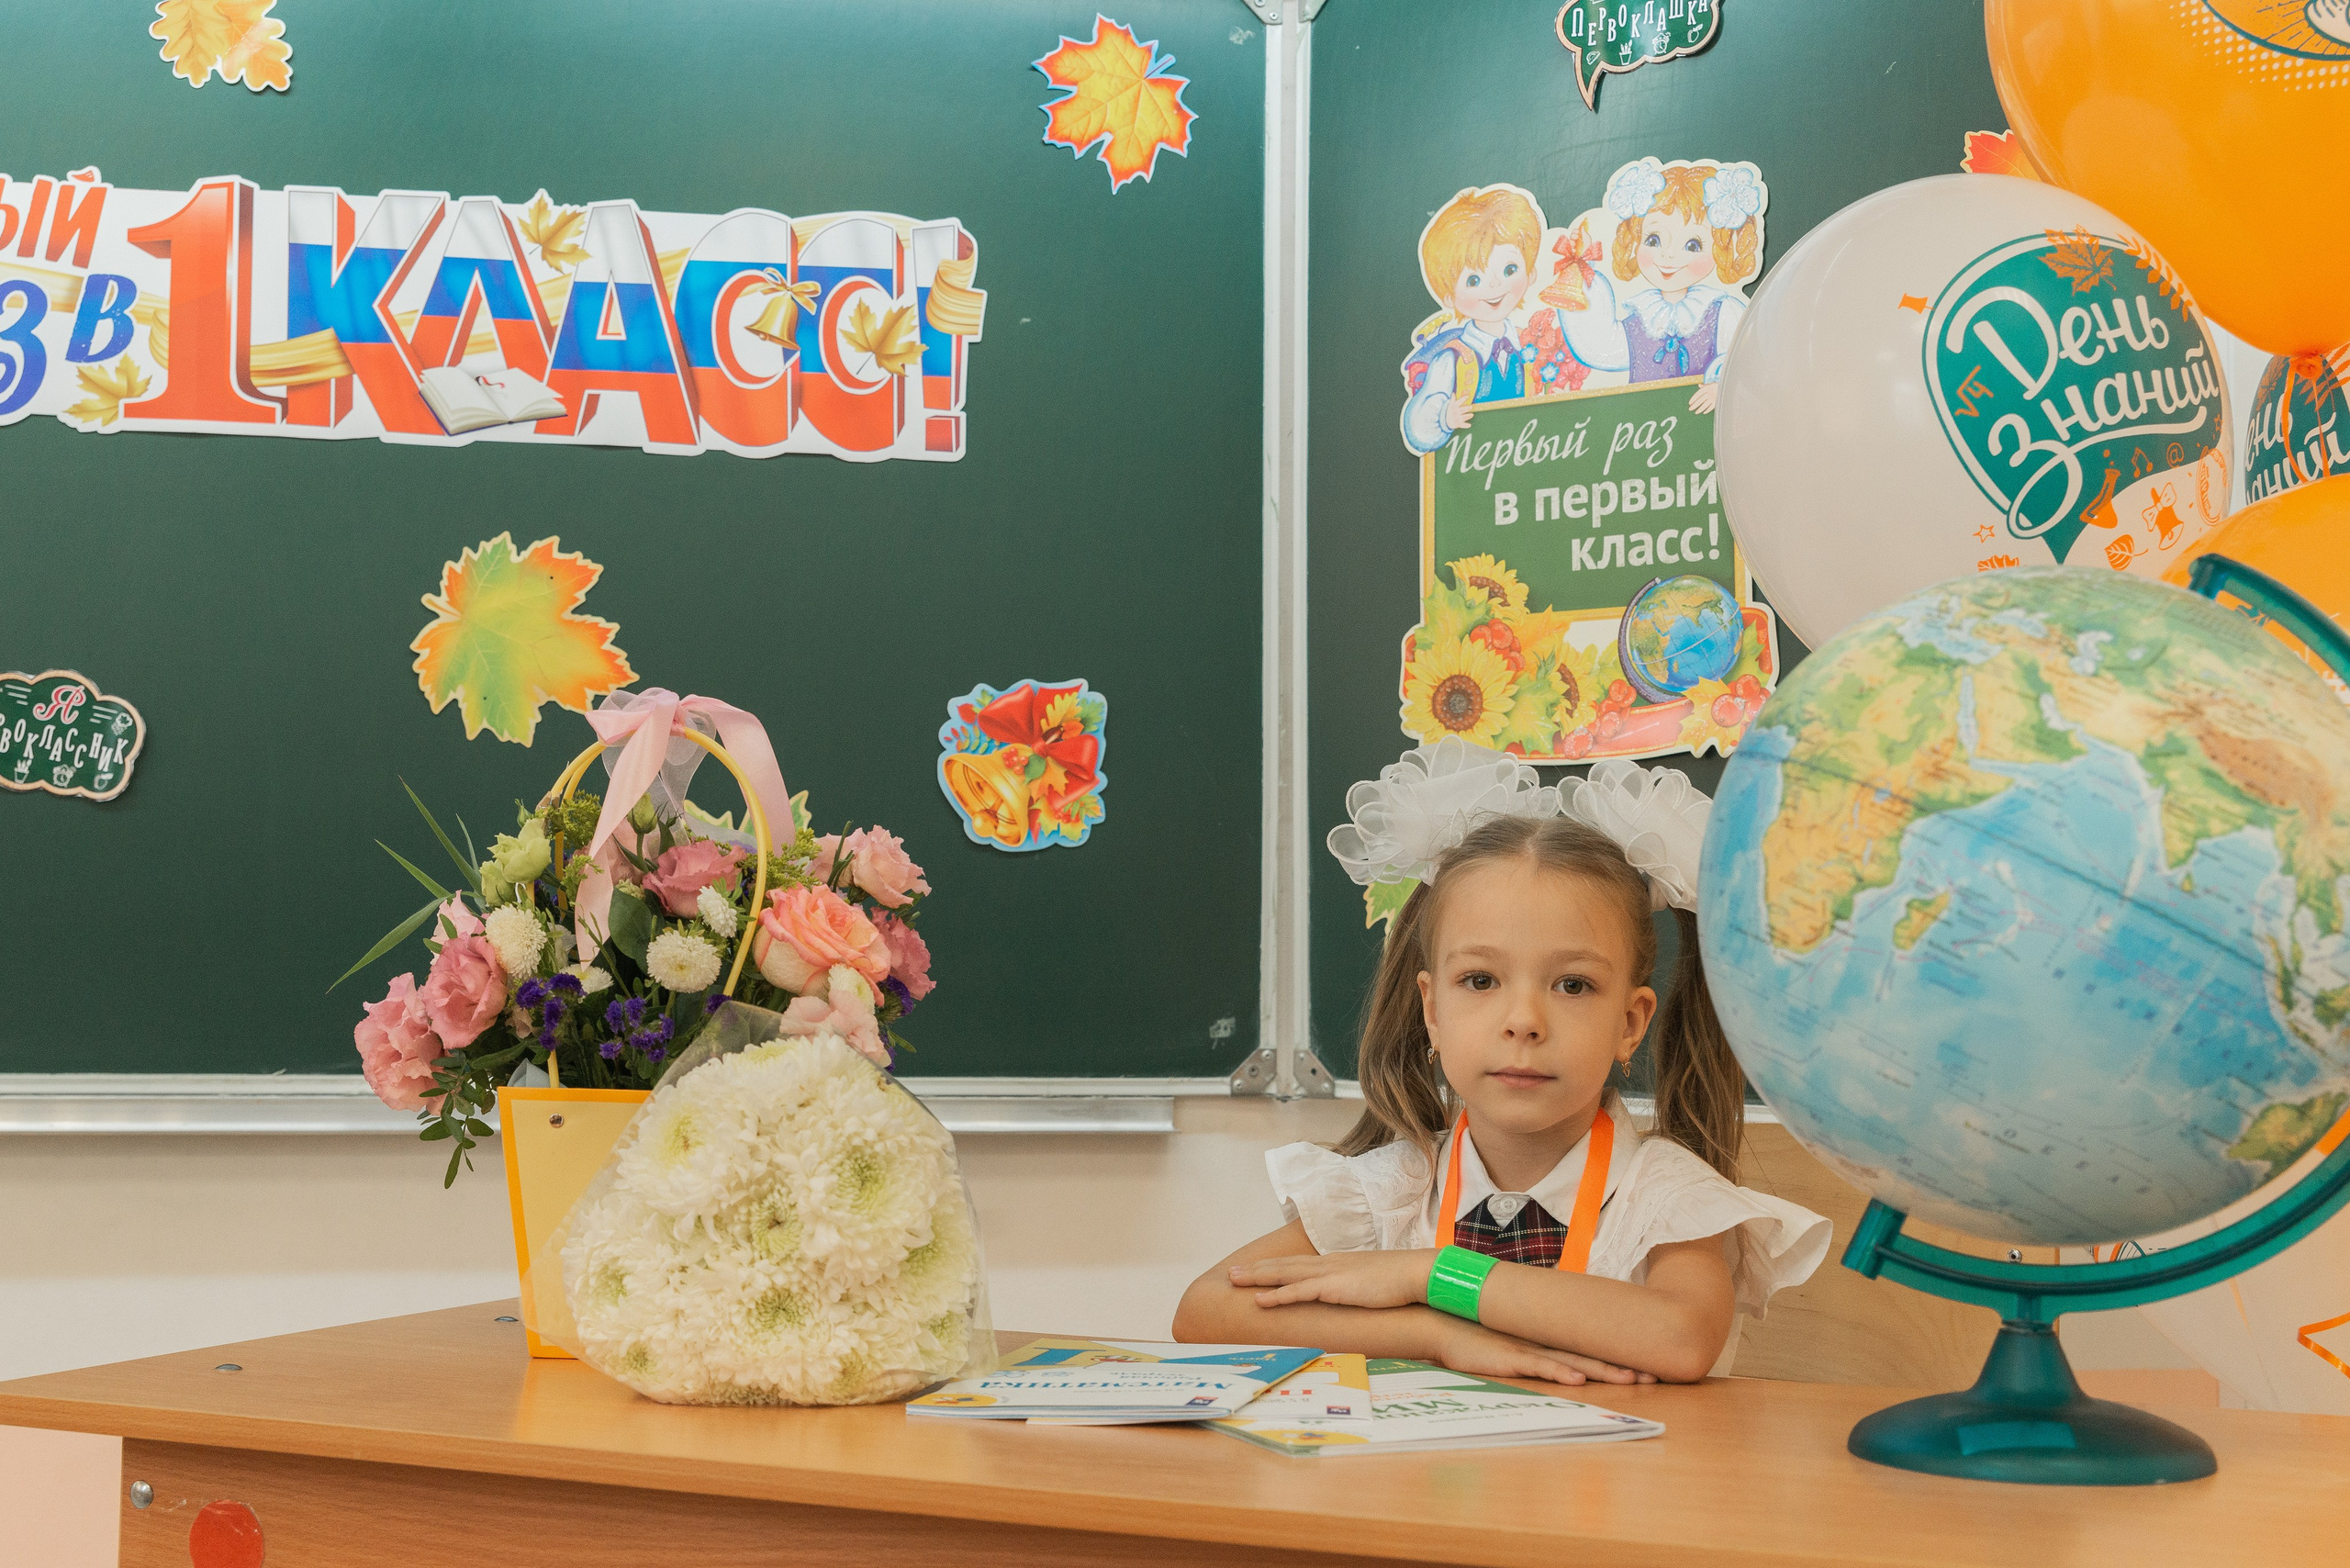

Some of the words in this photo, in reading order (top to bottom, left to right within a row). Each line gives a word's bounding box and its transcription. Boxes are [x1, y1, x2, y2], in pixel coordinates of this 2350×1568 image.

[124, 181, 288, 424] 1
[285, 189, 973, 453] КЛАСС!
[1945, 285, 2170, 400] День
[1444, 417, 1592, 490] Первый
[1603, 415, 1678, 476] раз
[1987, 341, 2220, 540] Знаний
[2245, 411, 2350, 505] аний
[1494, 492, 1519, 526] в
[1534, 459, 1718, 529] первый
[1571, 512, 1721, 572] класс!
[32, 684, 87, 725] Я
